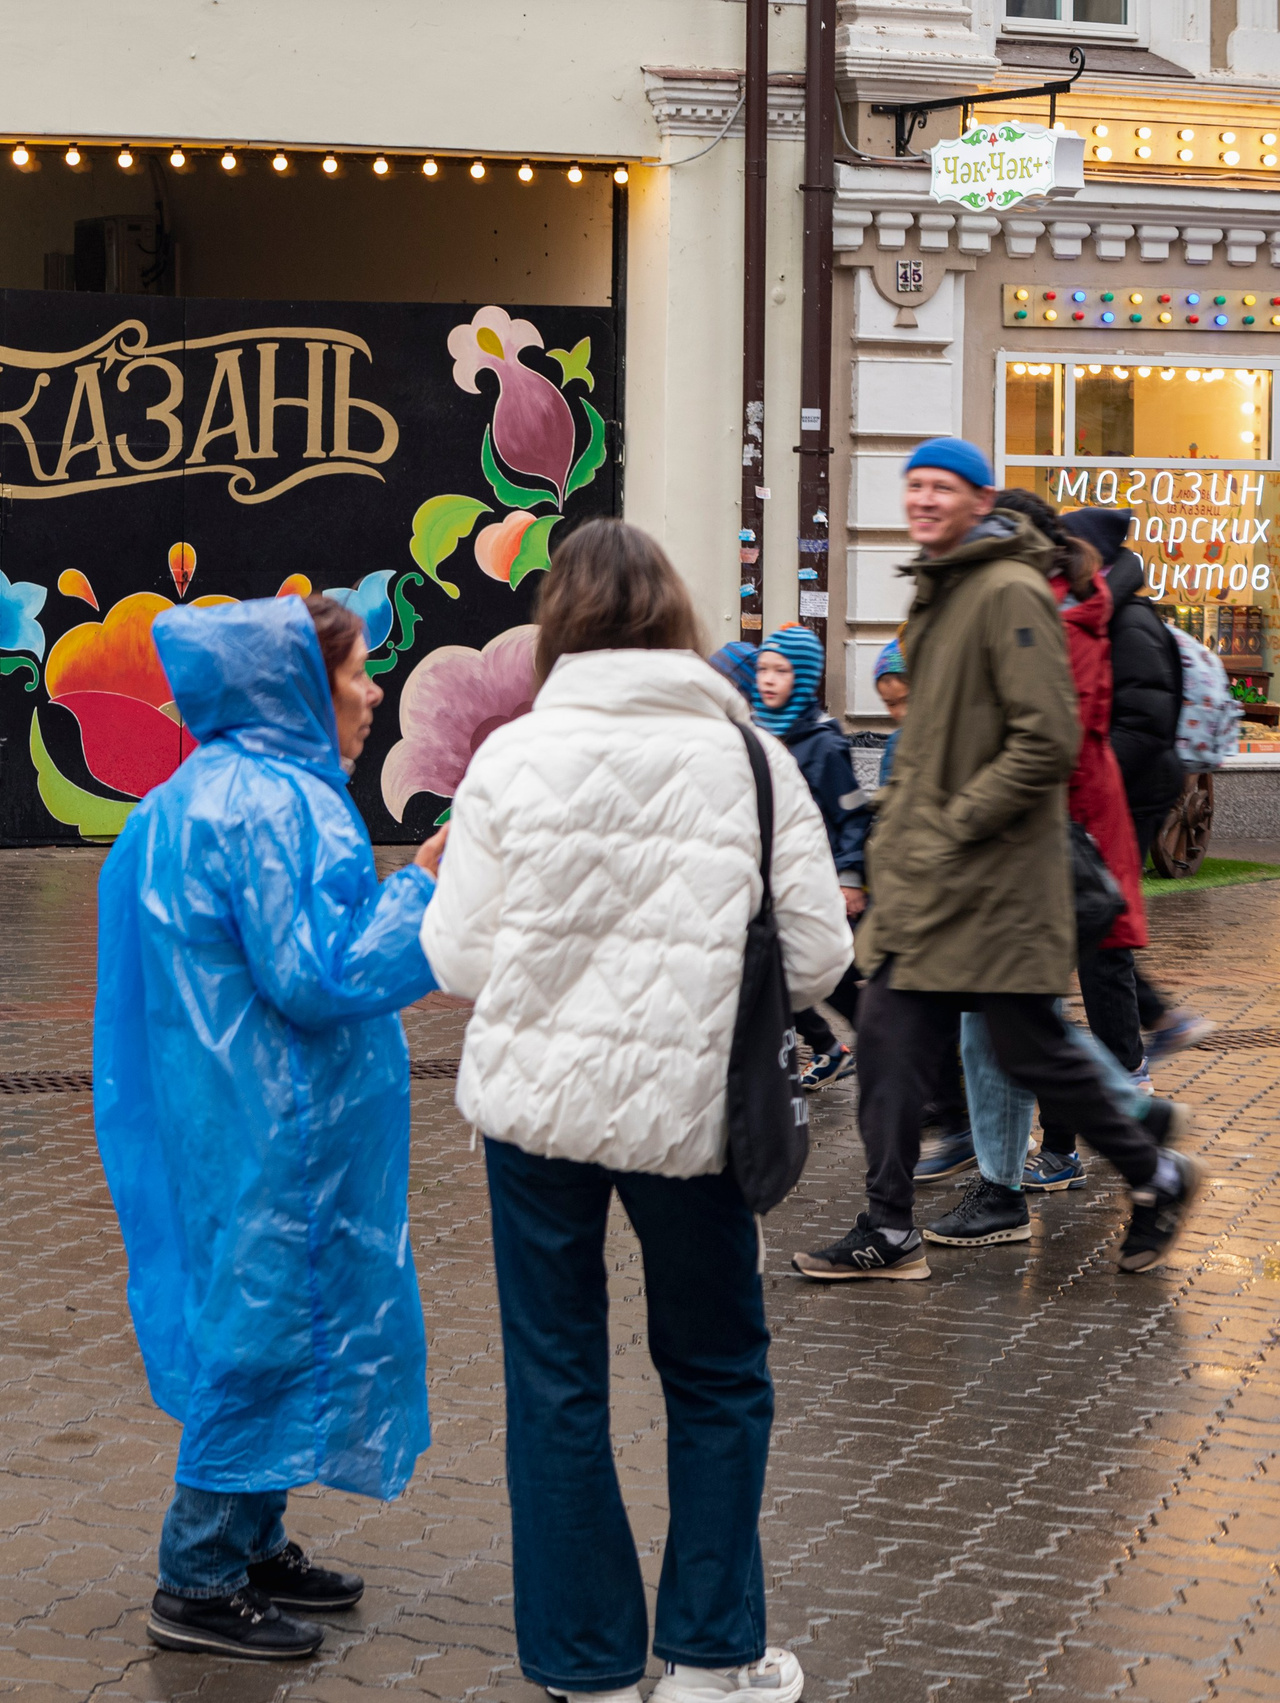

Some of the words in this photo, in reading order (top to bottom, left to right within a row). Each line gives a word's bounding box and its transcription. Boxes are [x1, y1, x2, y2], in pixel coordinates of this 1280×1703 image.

[899, 269, 922, 283] 45
[1056, 469, 1265, 506] магазин
[1133, 552, 1270, 601] уктов
[852, 1245, 885, 1270] N
